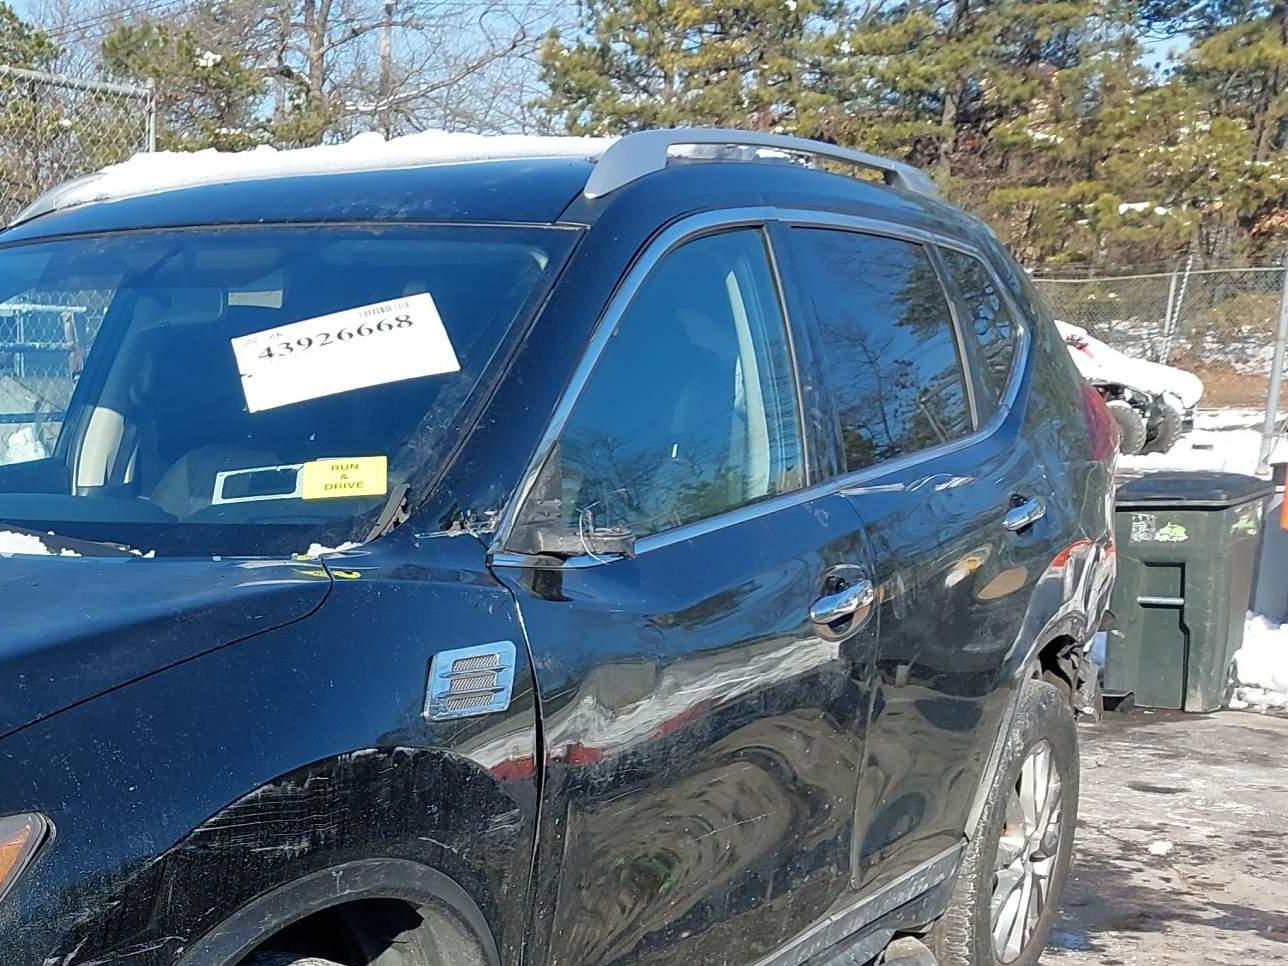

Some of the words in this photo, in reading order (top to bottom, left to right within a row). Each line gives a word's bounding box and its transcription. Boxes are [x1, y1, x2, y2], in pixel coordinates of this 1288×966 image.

[258, 314, 414, 359] 43926668
[330, 463, 359, 471] RUN
[324, 481, 365, 491] DRIVE
